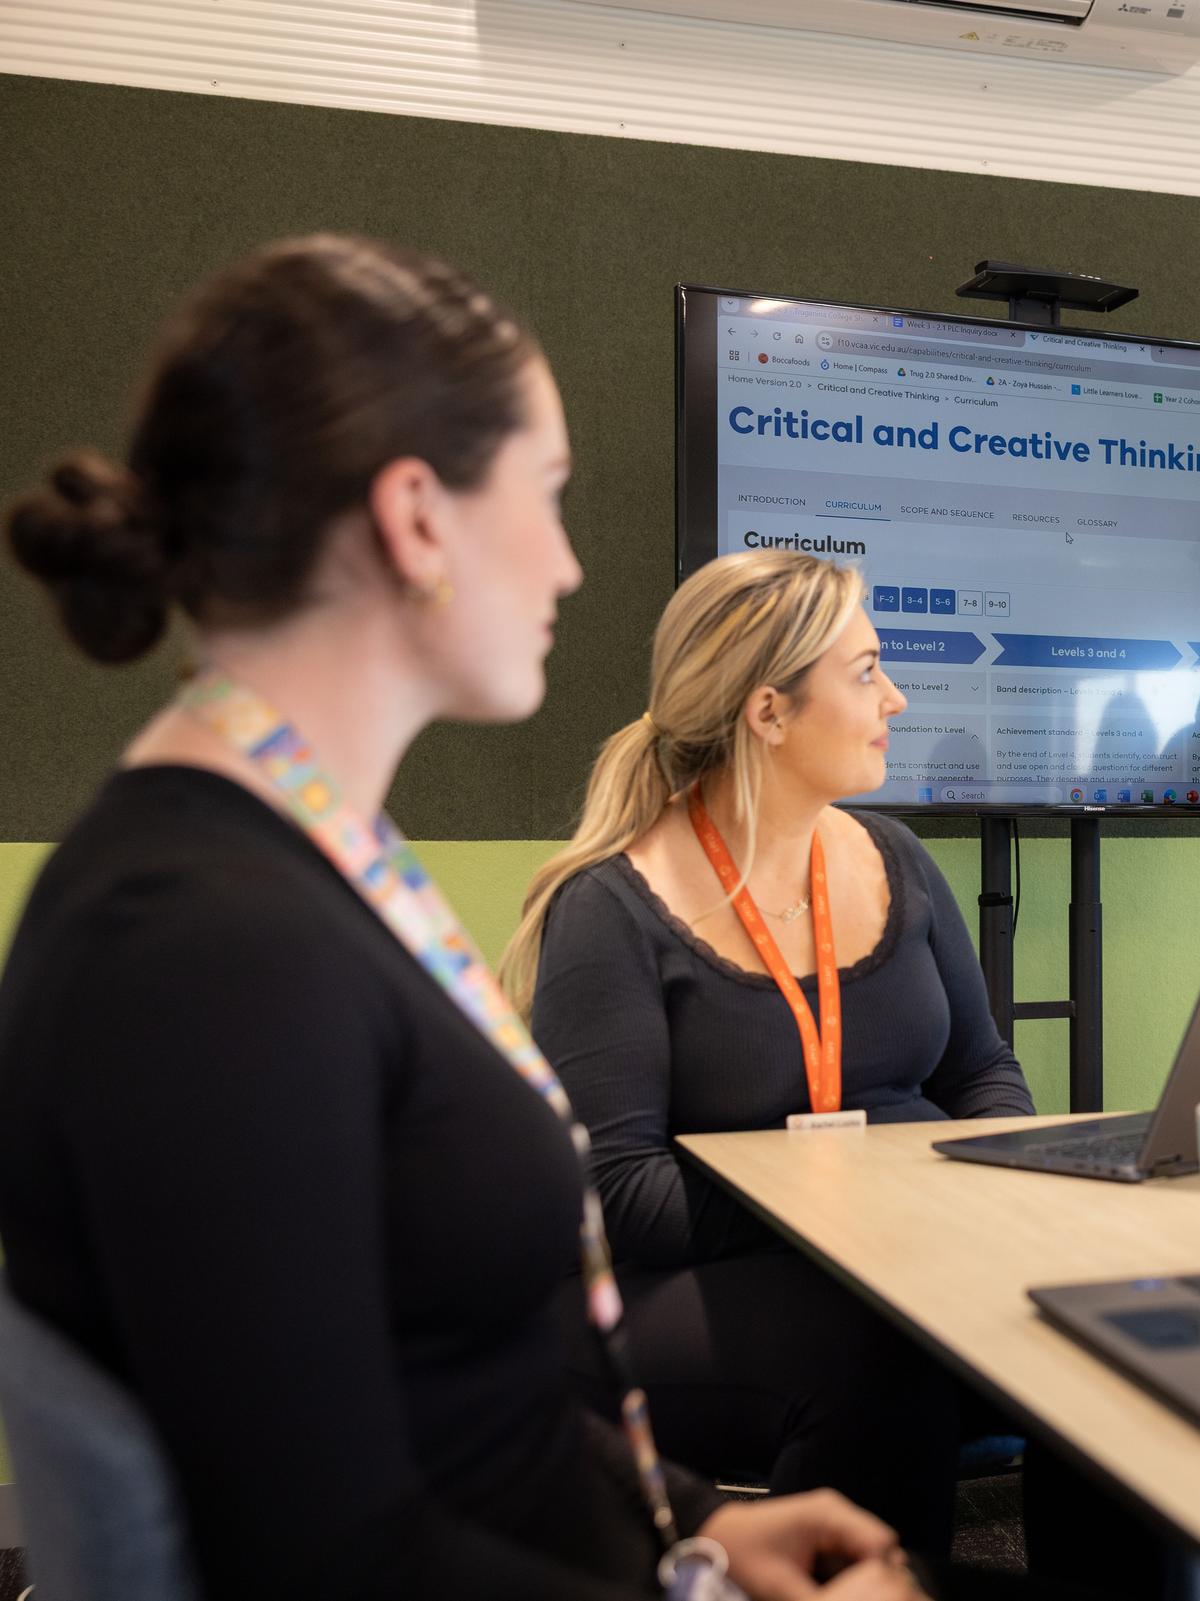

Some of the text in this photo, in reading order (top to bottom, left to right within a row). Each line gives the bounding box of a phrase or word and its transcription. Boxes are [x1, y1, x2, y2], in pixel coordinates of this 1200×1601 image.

[906, 320, 925, 329] Week
[1043, 335, 1128, 353] Critical and Creative Thinking
[772, 355, 810, 367] Boccafoods
[833, 362, 888, 375] Home Compass
[910, 370, 923, 380] Trug
[925, 371, 935, 379] 2.0
[936, 372, 958, 381] Shared
[728, 375, 802, 389] Home Version 2.0
[998, 377, 1007, 386] 2A
[1029, 381, 1052, 391] Hussain
[817, 382, 940, 403] Critical and Creative Thinking
[1083, 386, 1124, 398] Little Learners
[953, 395, 999, 408] Curriculum
[1165, 395, 1178, 404] Year
[728, 405, 863, 445] Critical
[872, 422, 939, 451] and
[949, 425, 1090, 464] Creative
[738, 494, 806, 506] INTRODUCTION
[825, 500, 882, 512] CURRICULUM
[900, 505, 995, 520] SCOPE AND SEQUENCE
[1012, 513, 1060, 524] RESOURCES
[1077, 517, 1118, 528] GLOSSARY
[743, 530, 866, 555] Curriculum
[892, 640, 945, 652] to Level 2
[1051, 646, 1127, 659] Levels 3 and 4
[911, 682, 944, 691] to Level
[996, 685, 1062, 696] Band description
[934, 726, 944, 734] to
[944, 726, 966, 735] Level
[996, 727, 1047, 737] Achievement
[1122, 730, 1136, 738] and
[996, 750, 1008, 760] By
[1008, 750, 1021, 759] the
[1022, 750, 1038, 759] end
[908, 762, 947, 770] construct
[948, 761, 964, 770] and
[996, 762, 1012, 771] and
[1028, 764, 1048, 773] open
[1141, 764, 1174, 773] different
[961, 791, 985, 800] Search
